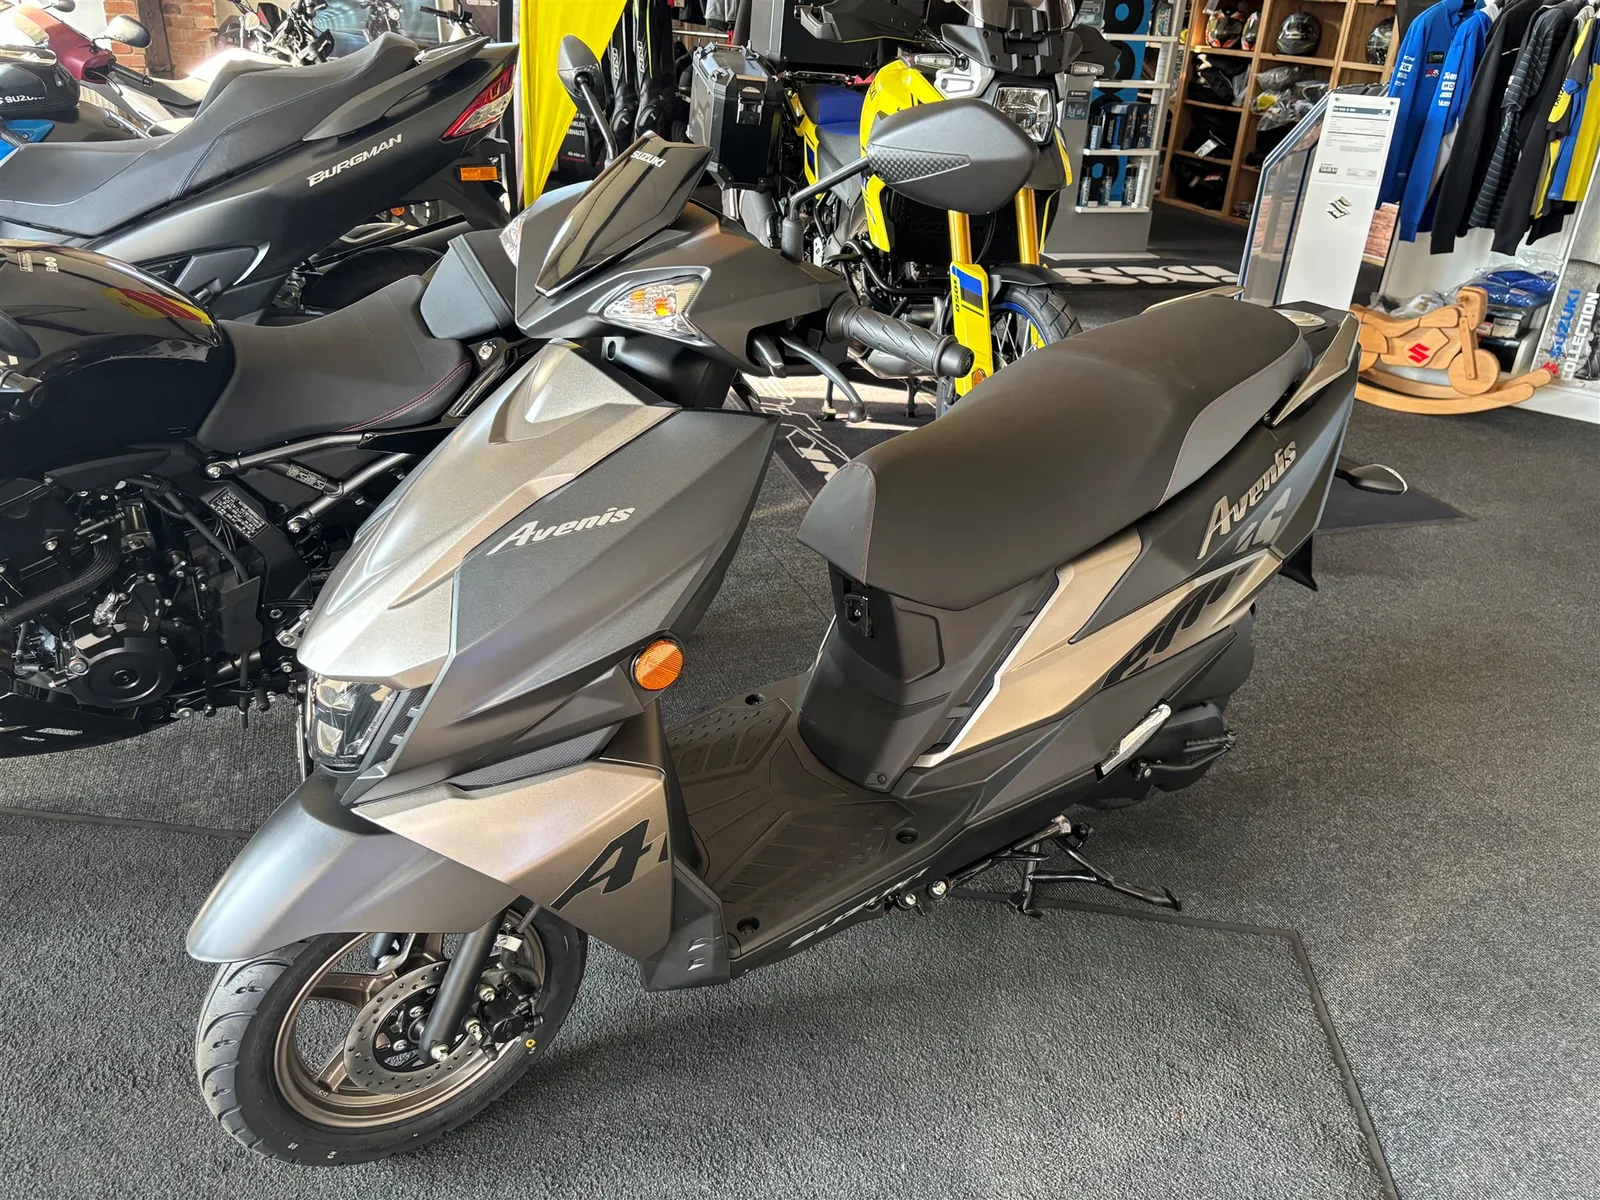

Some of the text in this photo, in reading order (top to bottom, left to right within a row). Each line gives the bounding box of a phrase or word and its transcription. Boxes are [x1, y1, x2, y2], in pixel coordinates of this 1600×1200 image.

[306, 133, 402, 188] BURGMAN
[630, 150, 667, 168] SUZUKI
[1549, 288, 1581, 359] SUZUKI
[1561, 291, 1600, 382] COLLECTION
[485, 507, 636, 556] Avenis
[1196, 440, 1297, 560] Avenis
